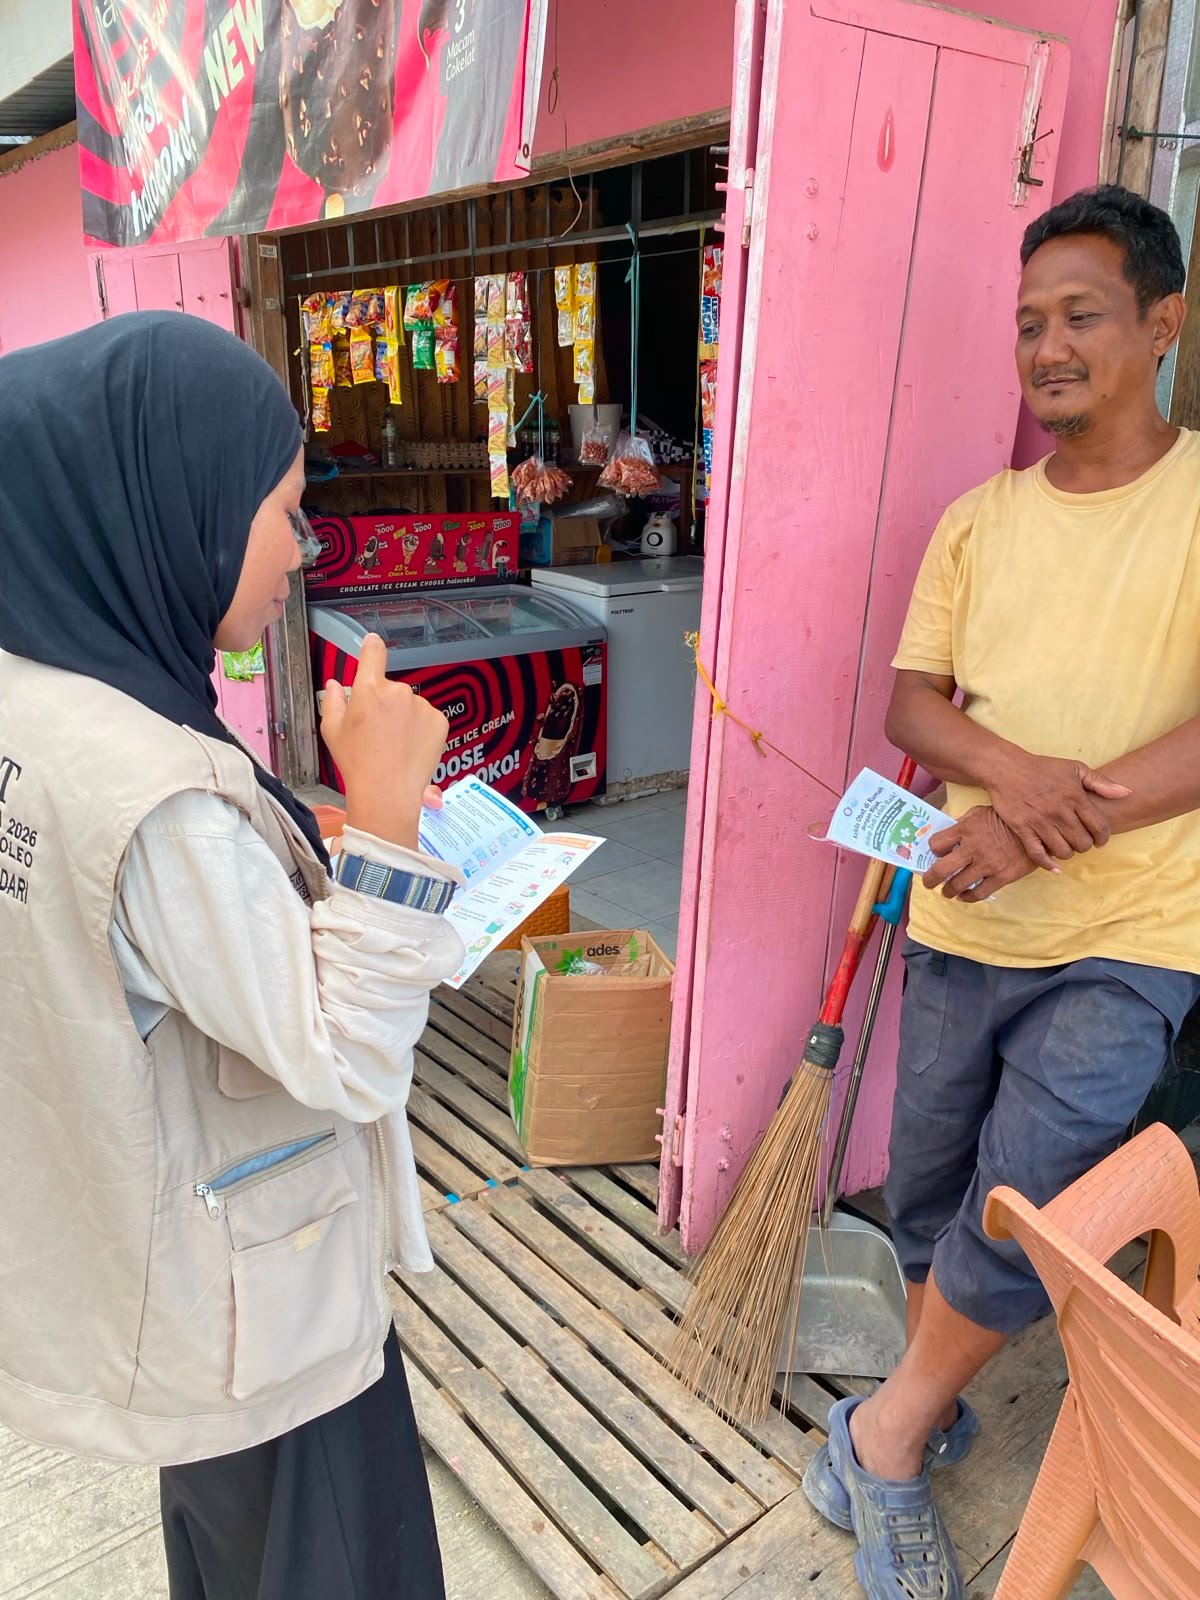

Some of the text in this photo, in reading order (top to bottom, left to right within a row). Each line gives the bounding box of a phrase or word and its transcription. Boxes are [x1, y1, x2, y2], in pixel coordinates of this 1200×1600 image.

[454, 0, 465, 33] 3
[204, 0, 264, 111] NEW
[446, 28, 475, 64] Macam
[446, 46, 475, 82] Cokelat
[702, 297, 712, 344] WOW
[340, 584, 379, 593] CHOCOLATE
[395, 581, 417, 589] CREAM
[420, 579, 445, 587] CHOOSE
[463, 728, 479, 744] ICE
[481, 710, 515, 734] CREAM
[430, 743, 485, 784] OOSE
[7, 818, 38, 848] 2026
